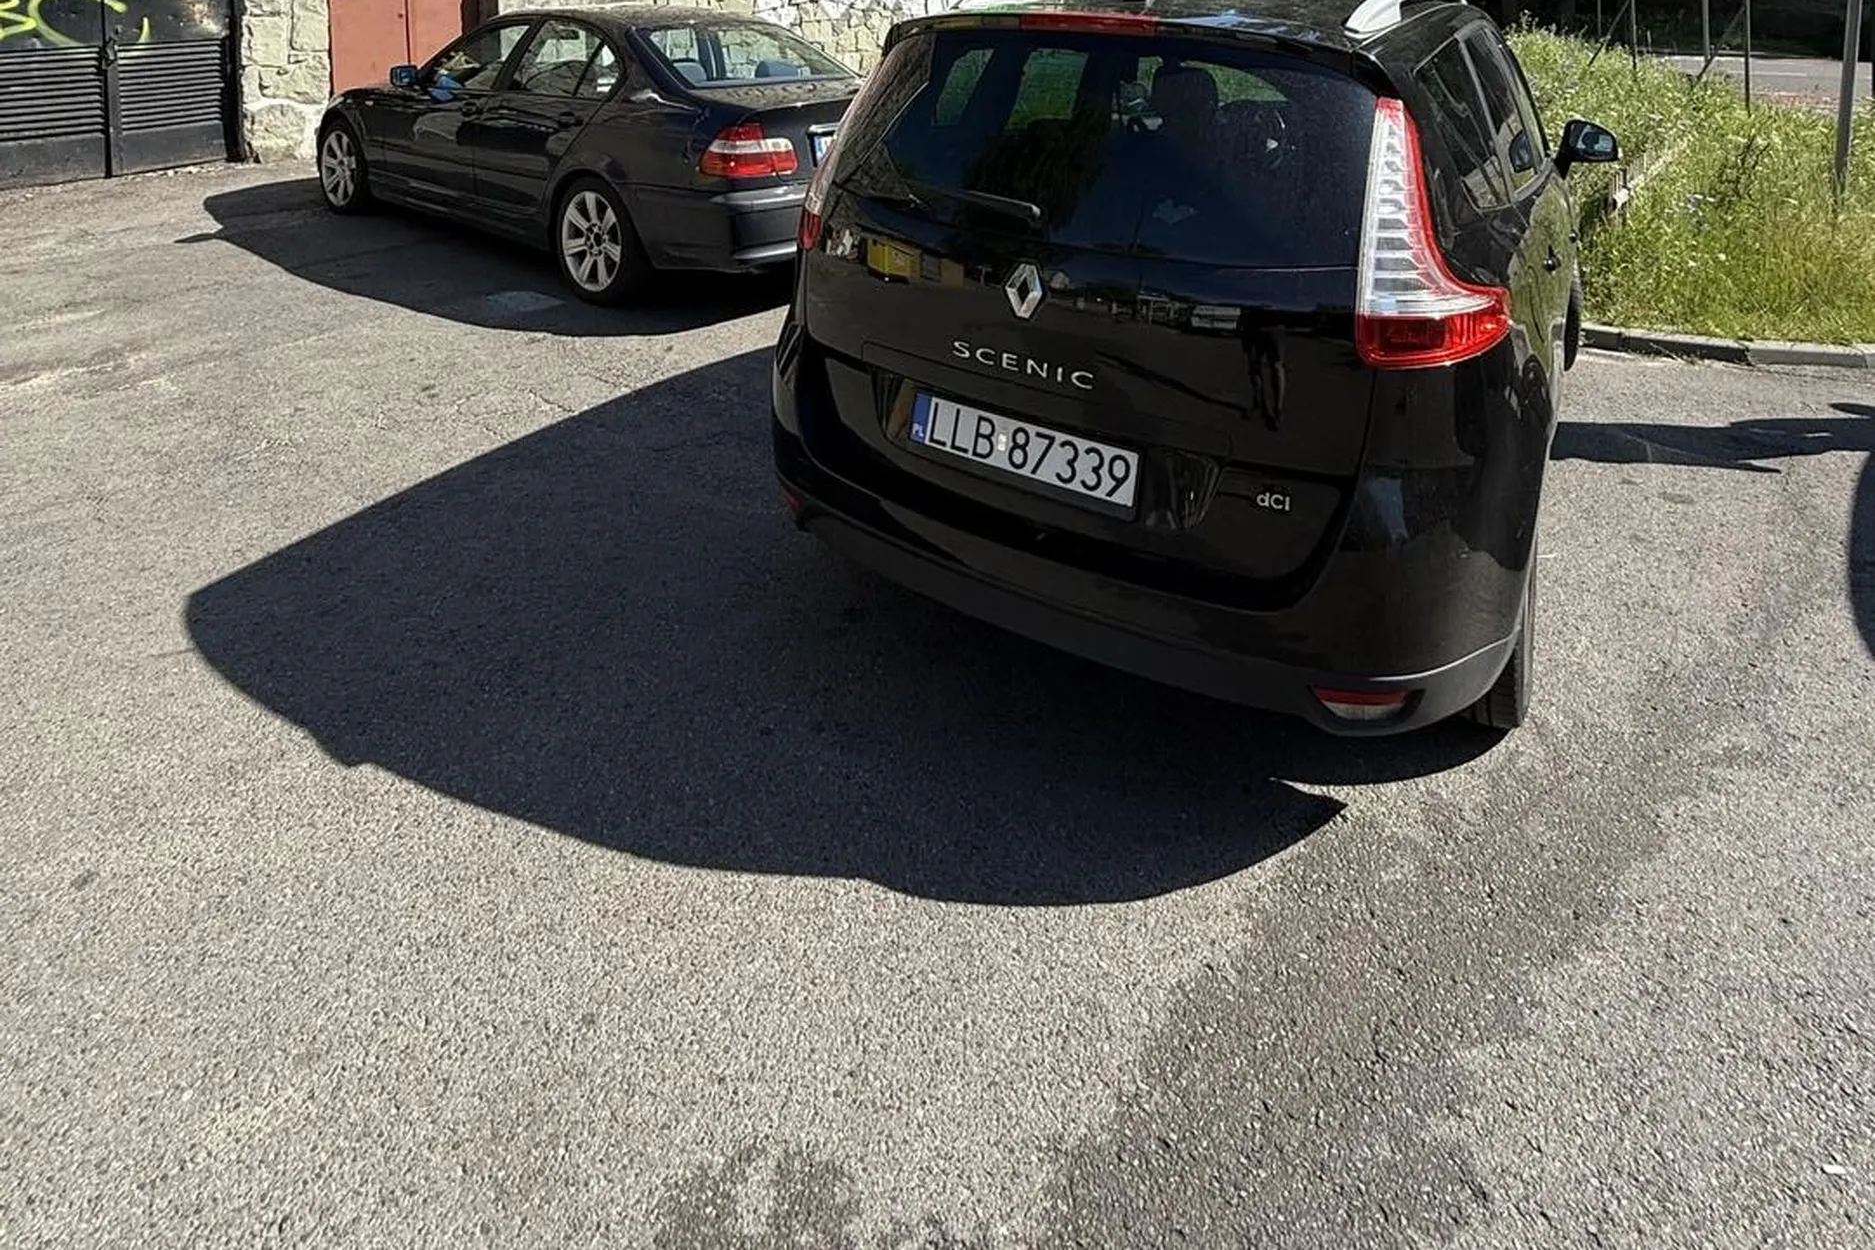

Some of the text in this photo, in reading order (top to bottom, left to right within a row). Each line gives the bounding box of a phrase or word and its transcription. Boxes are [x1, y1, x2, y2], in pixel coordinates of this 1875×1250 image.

[953, 340, 1095, 389] SCENIC
[928, 402, 996, 460] LLB
[1007, 426, 1131, 499] 87339
